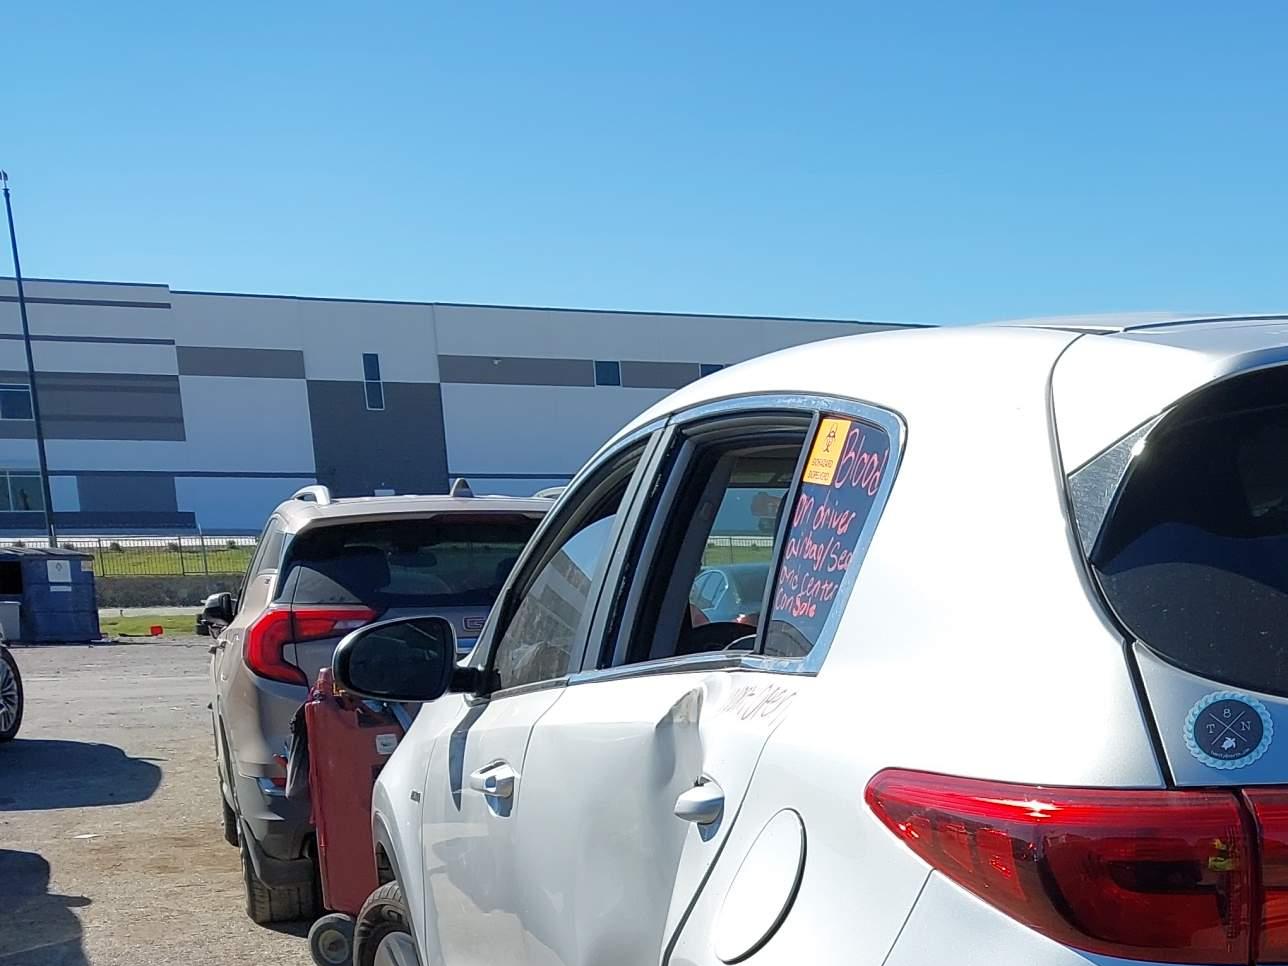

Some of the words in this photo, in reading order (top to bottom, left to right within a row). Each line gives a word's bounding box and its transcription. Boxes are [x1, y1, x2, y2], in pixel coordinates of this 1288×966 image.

[835, 428, 889, 496] Blood
[813, 488, 856, 535] driver
[1206, 723, 1215, 734] T
[1240, 720, 1252, 731] N
